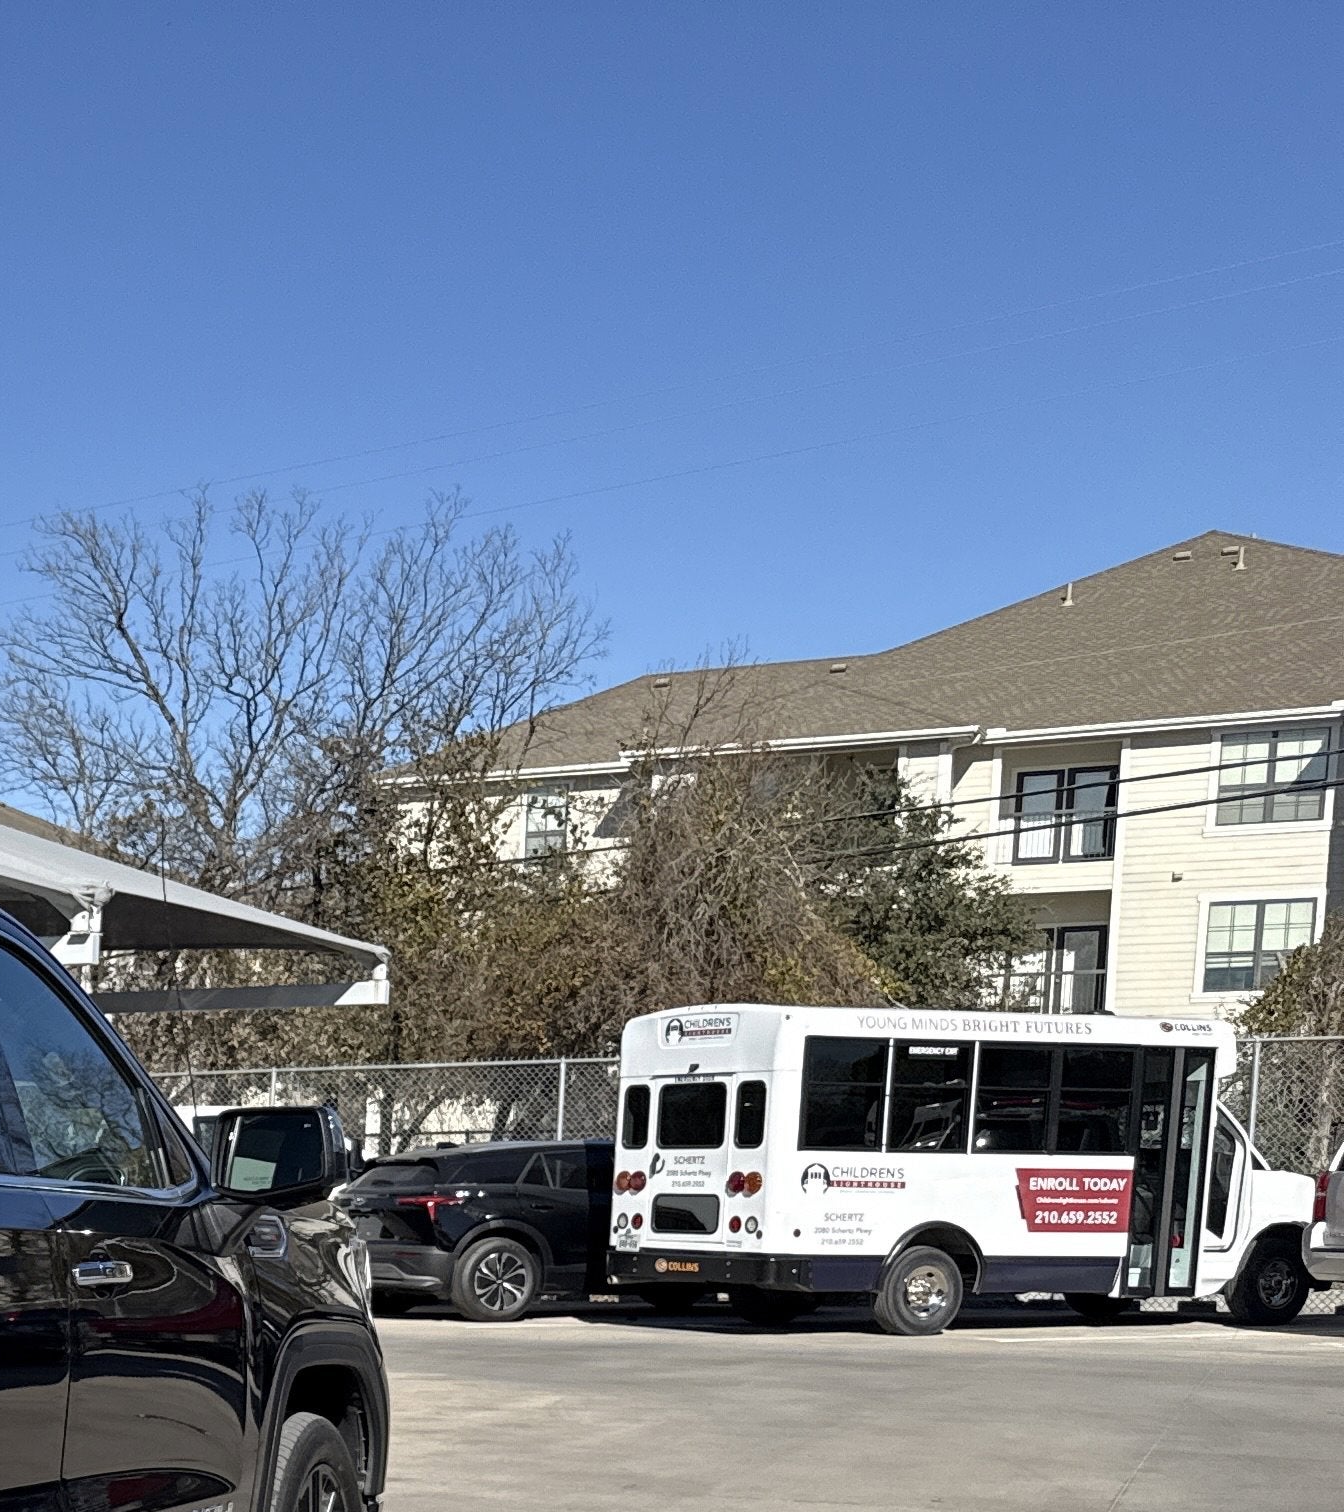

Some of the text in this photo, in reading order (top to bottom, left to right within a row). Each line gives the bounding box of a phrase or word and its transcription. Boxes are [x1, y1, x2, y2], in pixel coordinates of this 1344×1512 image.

[857, 1015, 1093, 1035] YOUNG MINDS BRIGHT FUTURES
[832, 1166, 905, 1179] CHILDREN'S
[1029, 1177, 1128, 1192] ENROLL TODAY
[824, 1212, 865, 1222] SCHERTZ
[1034, 1210, 1118, 1224] 210.659.2552
[668, 1261, 700, 1272] COLLINS
